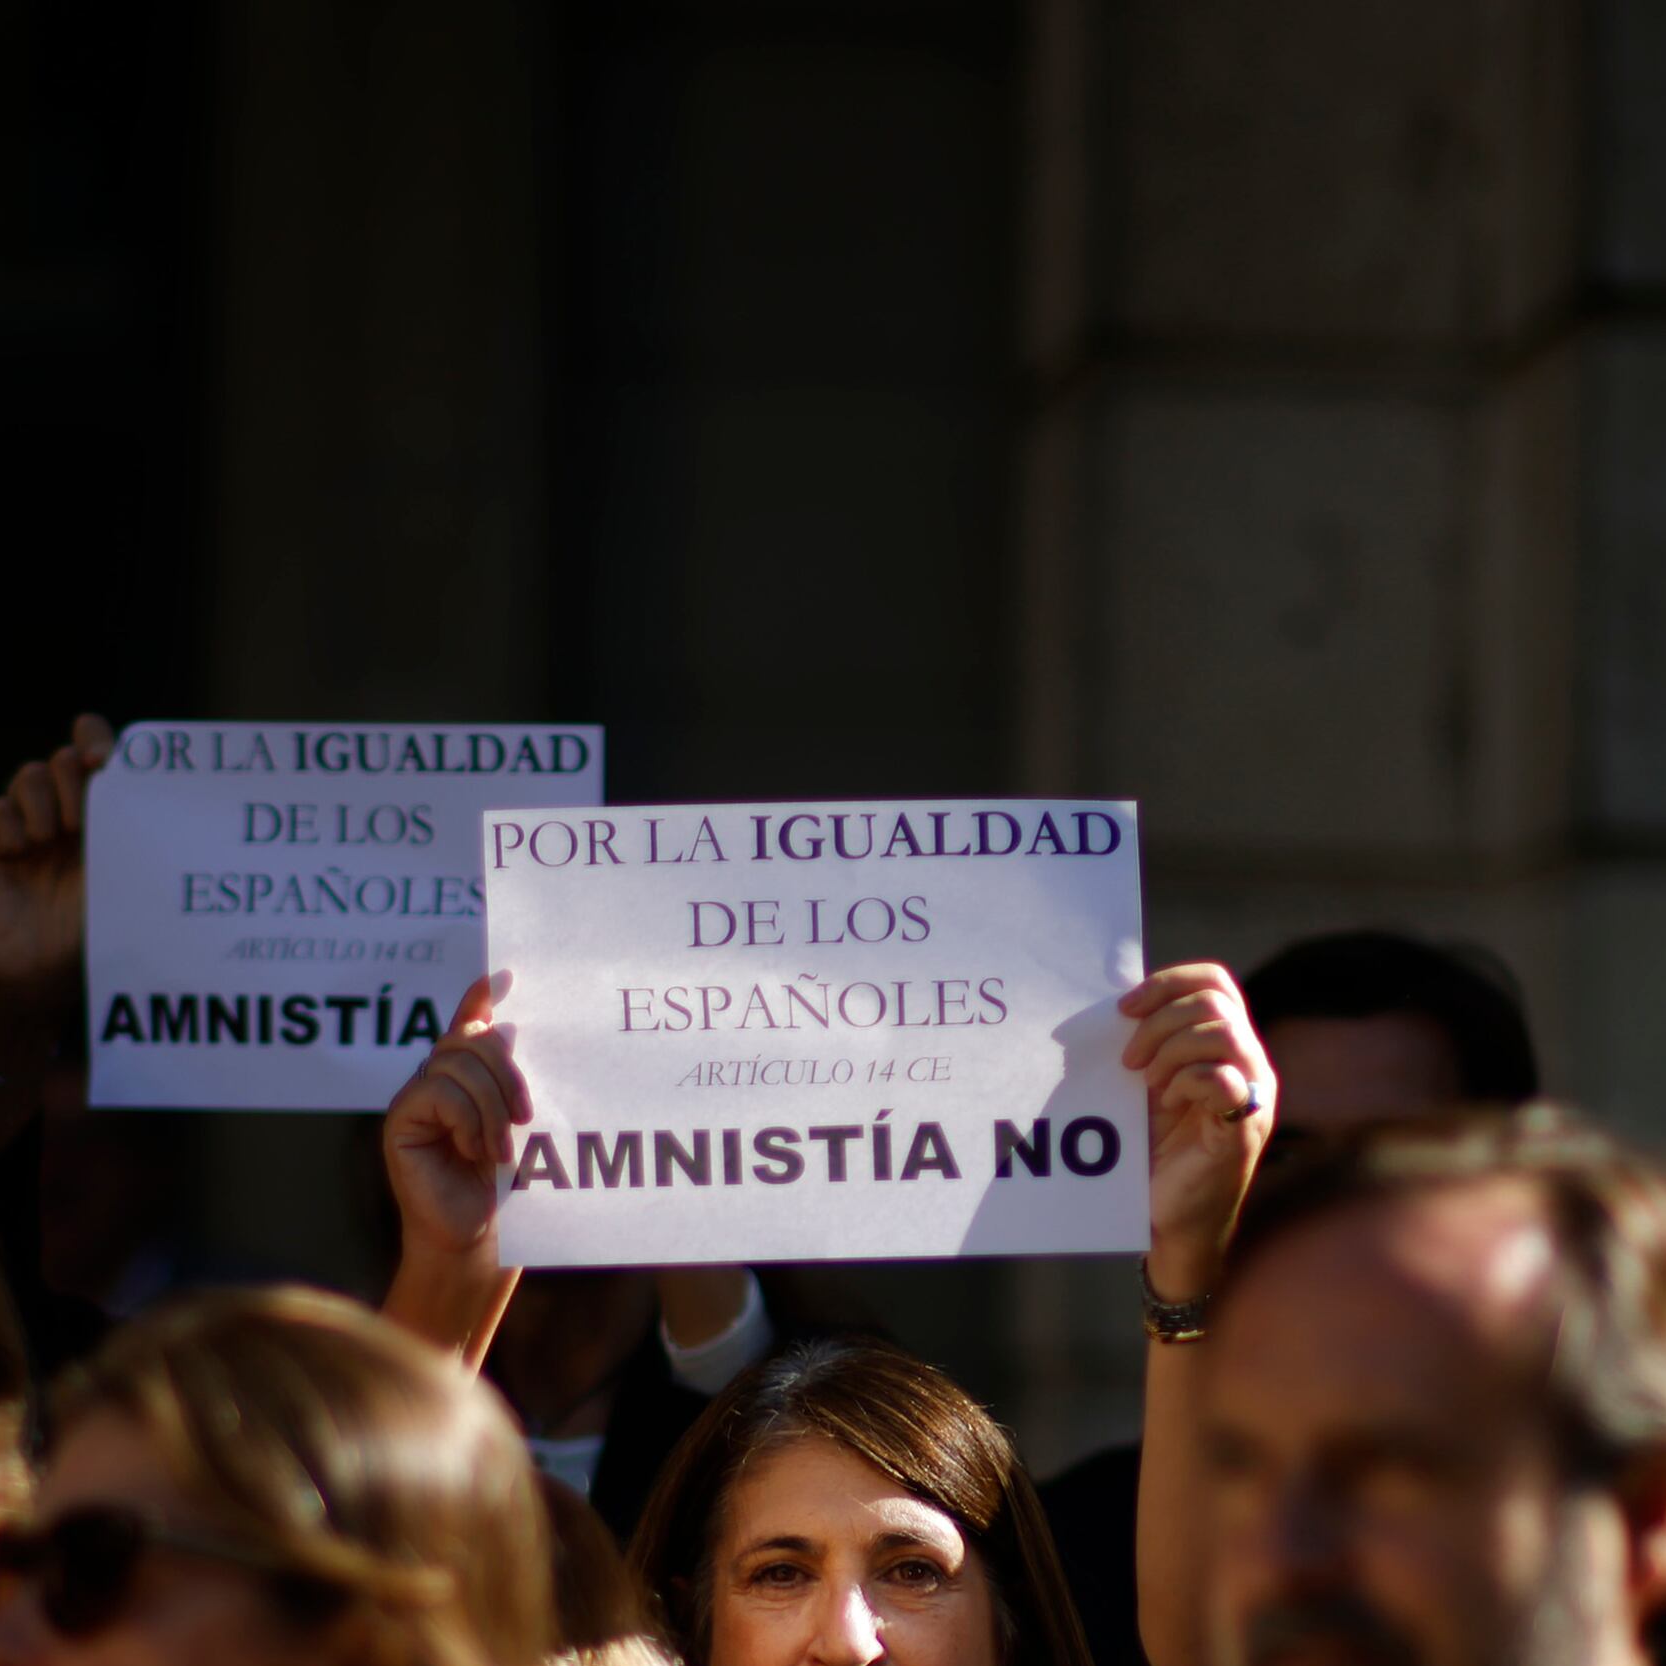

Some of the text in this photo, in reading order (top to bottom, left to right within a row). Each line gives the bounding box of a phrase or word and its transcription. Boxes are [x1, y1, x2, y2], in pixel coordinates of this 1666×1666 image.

[123, 731, 590, 774] OR LA IGUALDAD
[243, 803, 435, 847] DE LOS
[493, 811, 1121, 869] POR LA IGUALDAD
[181, 867, 486, 917] ESPAÑOLES
[688, 895, 931, 948] DE LOS
[101, 985, 442, 1047] AMNISTÍA
[616, 972, 1009, 1034] ESPAÑOLES
[676, 1053, 953, 1088] ARTÍCULO 14 CE
[511, 1108, 1122, 1192] AMNISTÍA NO
